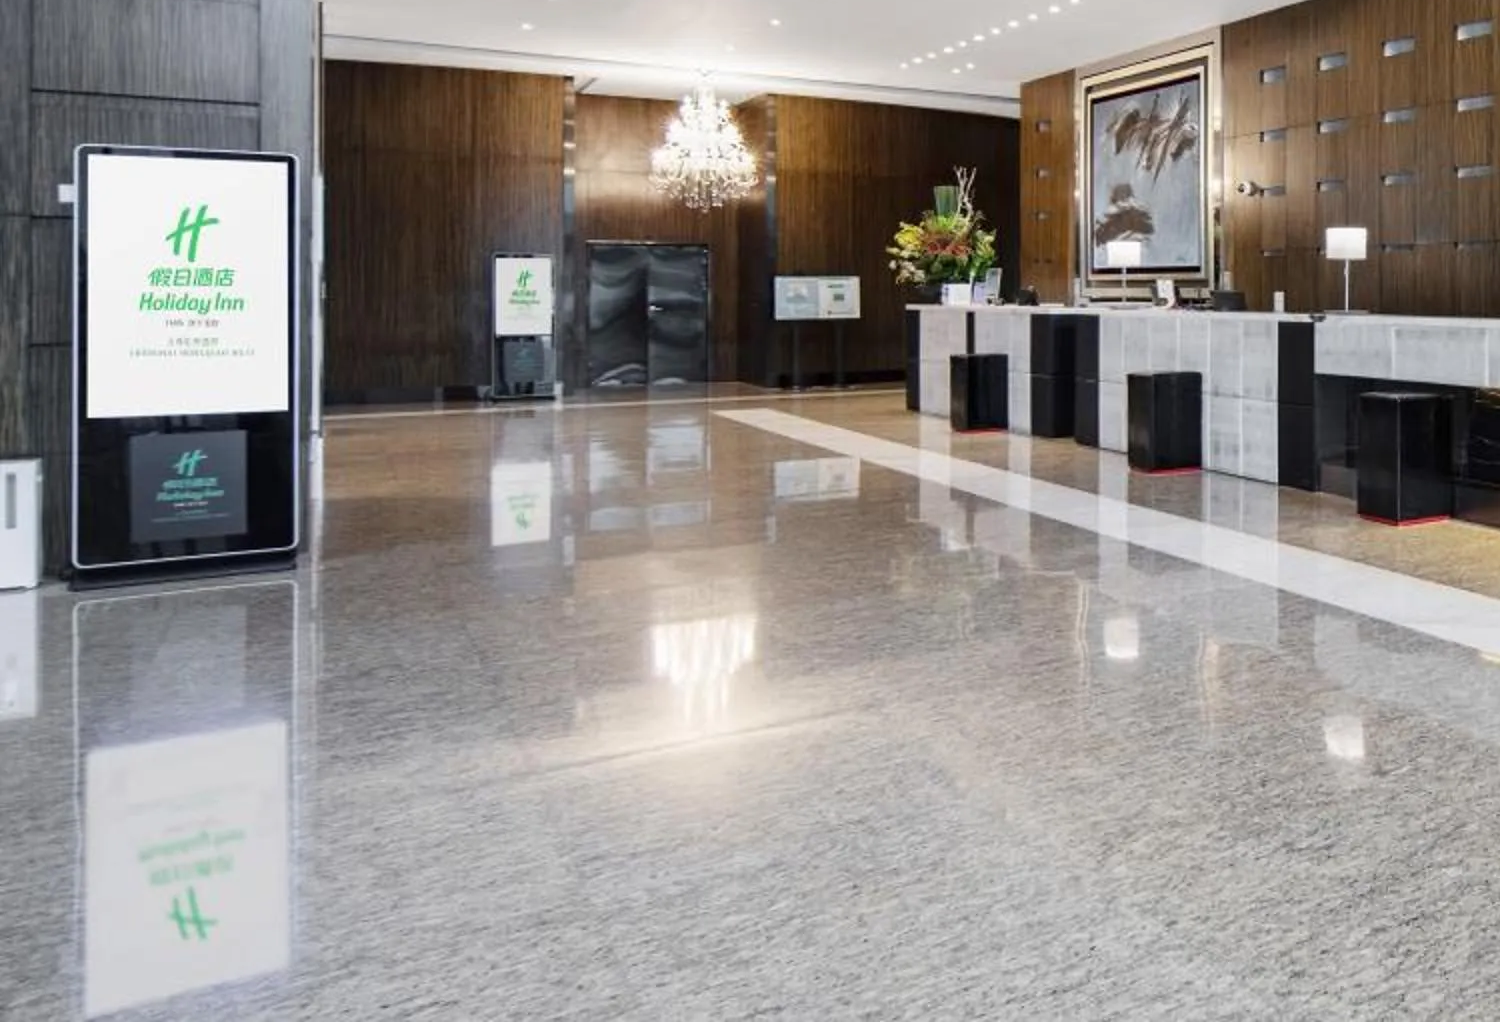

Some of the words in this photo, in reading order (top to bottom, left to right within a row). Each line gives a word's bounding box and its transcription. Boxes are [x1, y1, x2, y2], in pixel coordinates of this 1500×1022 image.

[148, 268, 235, 287] 假日酒店
[139, 292, 211, 315] Holiday
[215, 292, 244, 310] Inn
